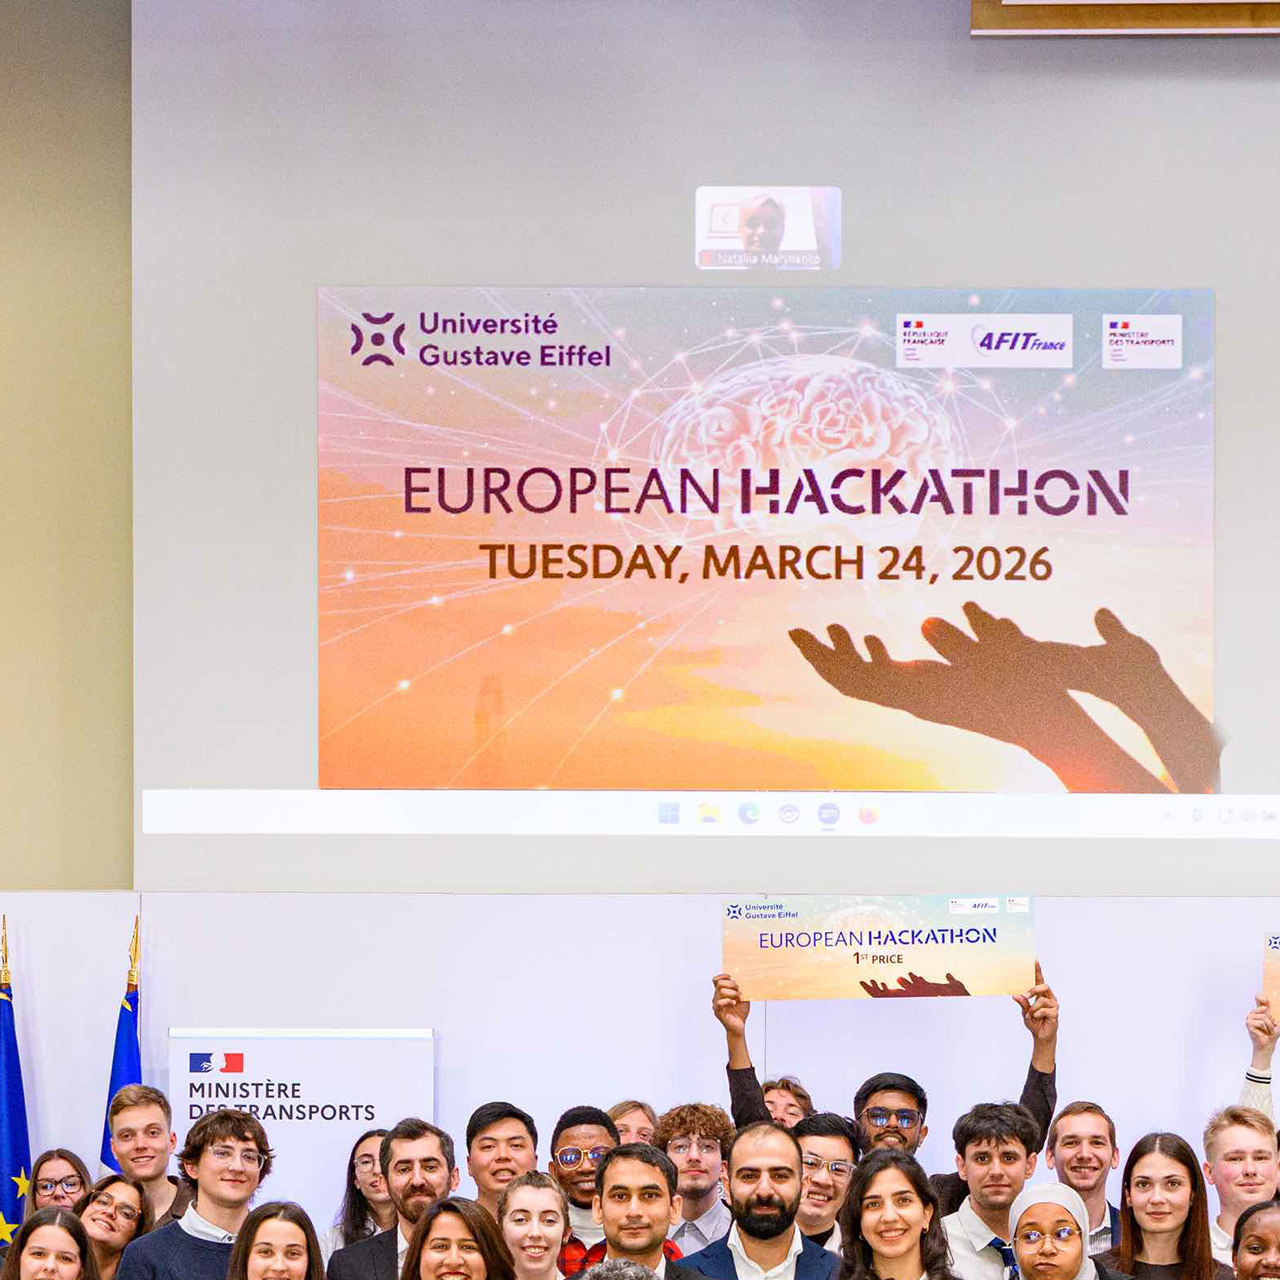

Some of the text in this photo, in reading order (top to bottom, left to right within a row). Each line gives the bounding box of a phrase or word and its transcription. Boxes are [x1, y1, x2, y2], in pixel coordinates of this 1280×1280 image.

[420, 312, 557, 334] Université
[980, 332, 1065, 351] AFIT France
[419, 345, 611, 366] Gustave Eiffel
[404, 467, 1129, 516] EUROPEAN HACKATHON
[479, 544, 1053, 584] TUESDAY, MARCH 24, 2026
[745, 903, 784, 911] Université
[745, 911, 776, 919] Gustave
[759, 928, 996, 948] EUROPEAN HACKATHON
[872, 954, 903, 964] PRICE
[189, 1079, 301, 1098] MINISTÈRE
